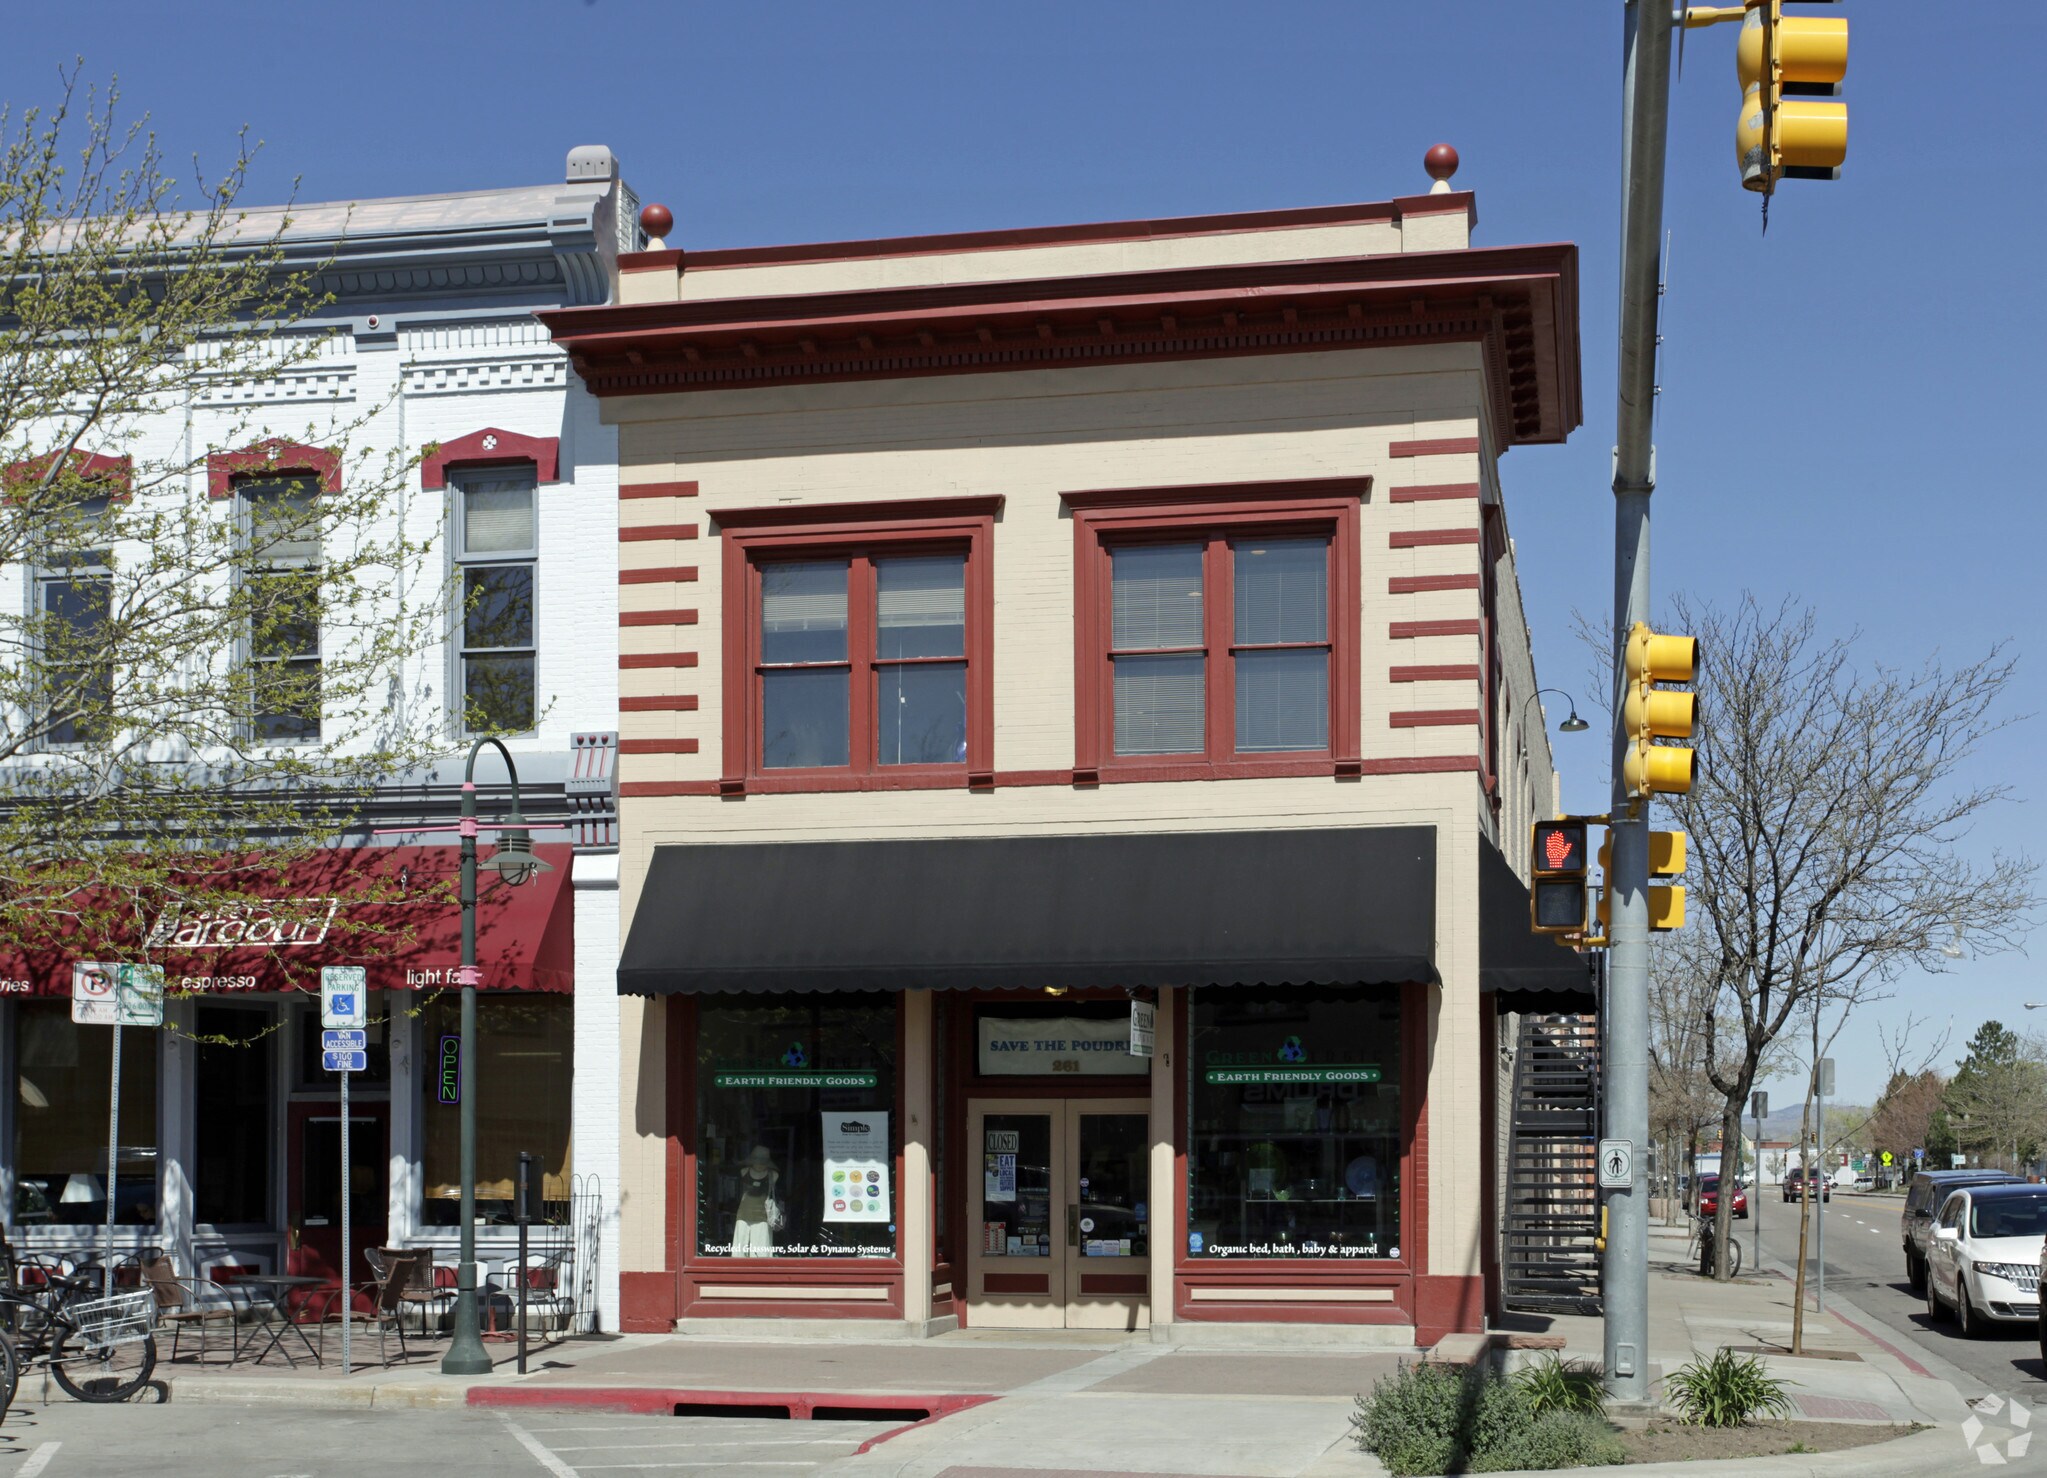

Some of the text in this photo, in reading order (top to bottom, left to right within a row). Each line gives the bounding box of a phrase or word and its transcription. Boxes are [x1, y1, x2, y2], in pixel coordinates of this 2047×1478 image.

[181, 975, 256, 990] espresso
[325, 973, 362, 981] RESERVED
[406, 969, 442, 988] light
[0, 977, 30, 992] ries
[327, 984, 360, 992] PARKING
[337, 1032, 351, 1040] VAN
[325, 1039, 363, 1048] ACCESSIBLE
[990, 1040, 1029, 1051] SAVE
[1034, 1040, 1066, 1051] THE
[332, 1052, 352, 1061] $100
[336, 1061, 353, 1069] FINE
[442, 1039, 458, 1100] OPEN
[1052, 1060, 1080, 1072] 261
[725, 1077, 866, 1085] EARTH FRIENDLY GOODS
[1217, 1071, 1369, 1081] EARTH FRIENDLY GOODS
[842, 1123, 869, 1134] Simple
[988, 1133, 1017, 1151] CLOSED
[999, 1155, 1014, 1167] EAT
[704, 1243, 891, 1256] Recycled Glassware, Solar & Dynamo Systems
[1209, 1244, 1248, 1257] Organic
[1249, 1243, 1271, 1254] bed,
[1302, 1243, 1327, 1257] baby
[1328, 1244, 1338, 1254] &
[1339, 1243, 1378, 1257] apparel
